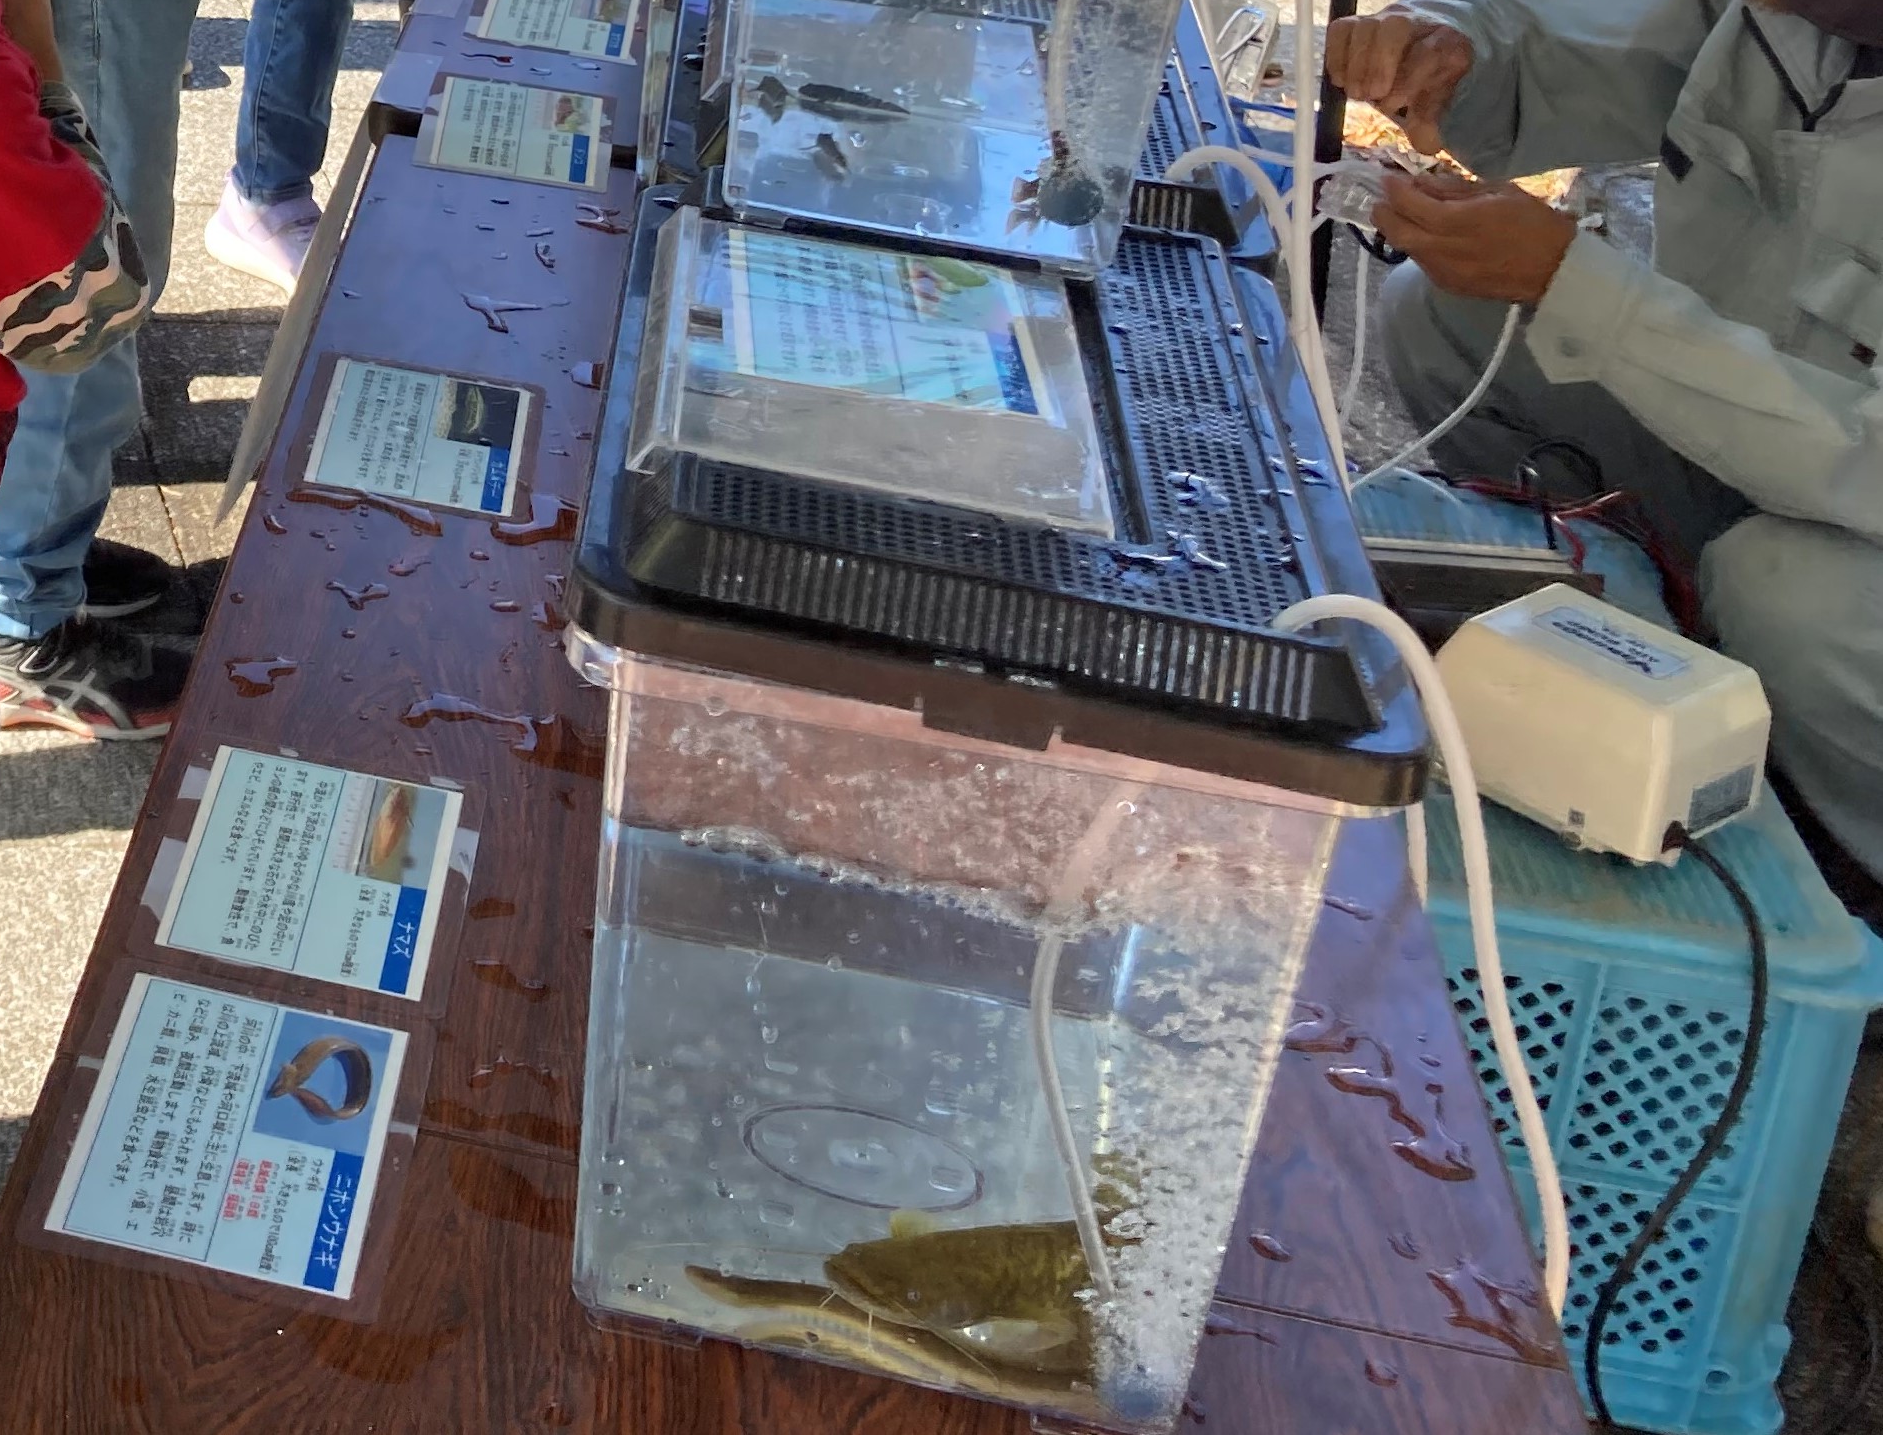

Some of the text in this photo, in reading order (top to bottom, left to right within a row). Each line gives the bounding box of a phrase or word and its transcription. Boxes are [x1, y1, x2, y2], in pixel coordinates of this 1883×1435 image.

[390, 919, 417, 958] ナマズ
[312, 1172, 354, 1269] ニホンウナギ
